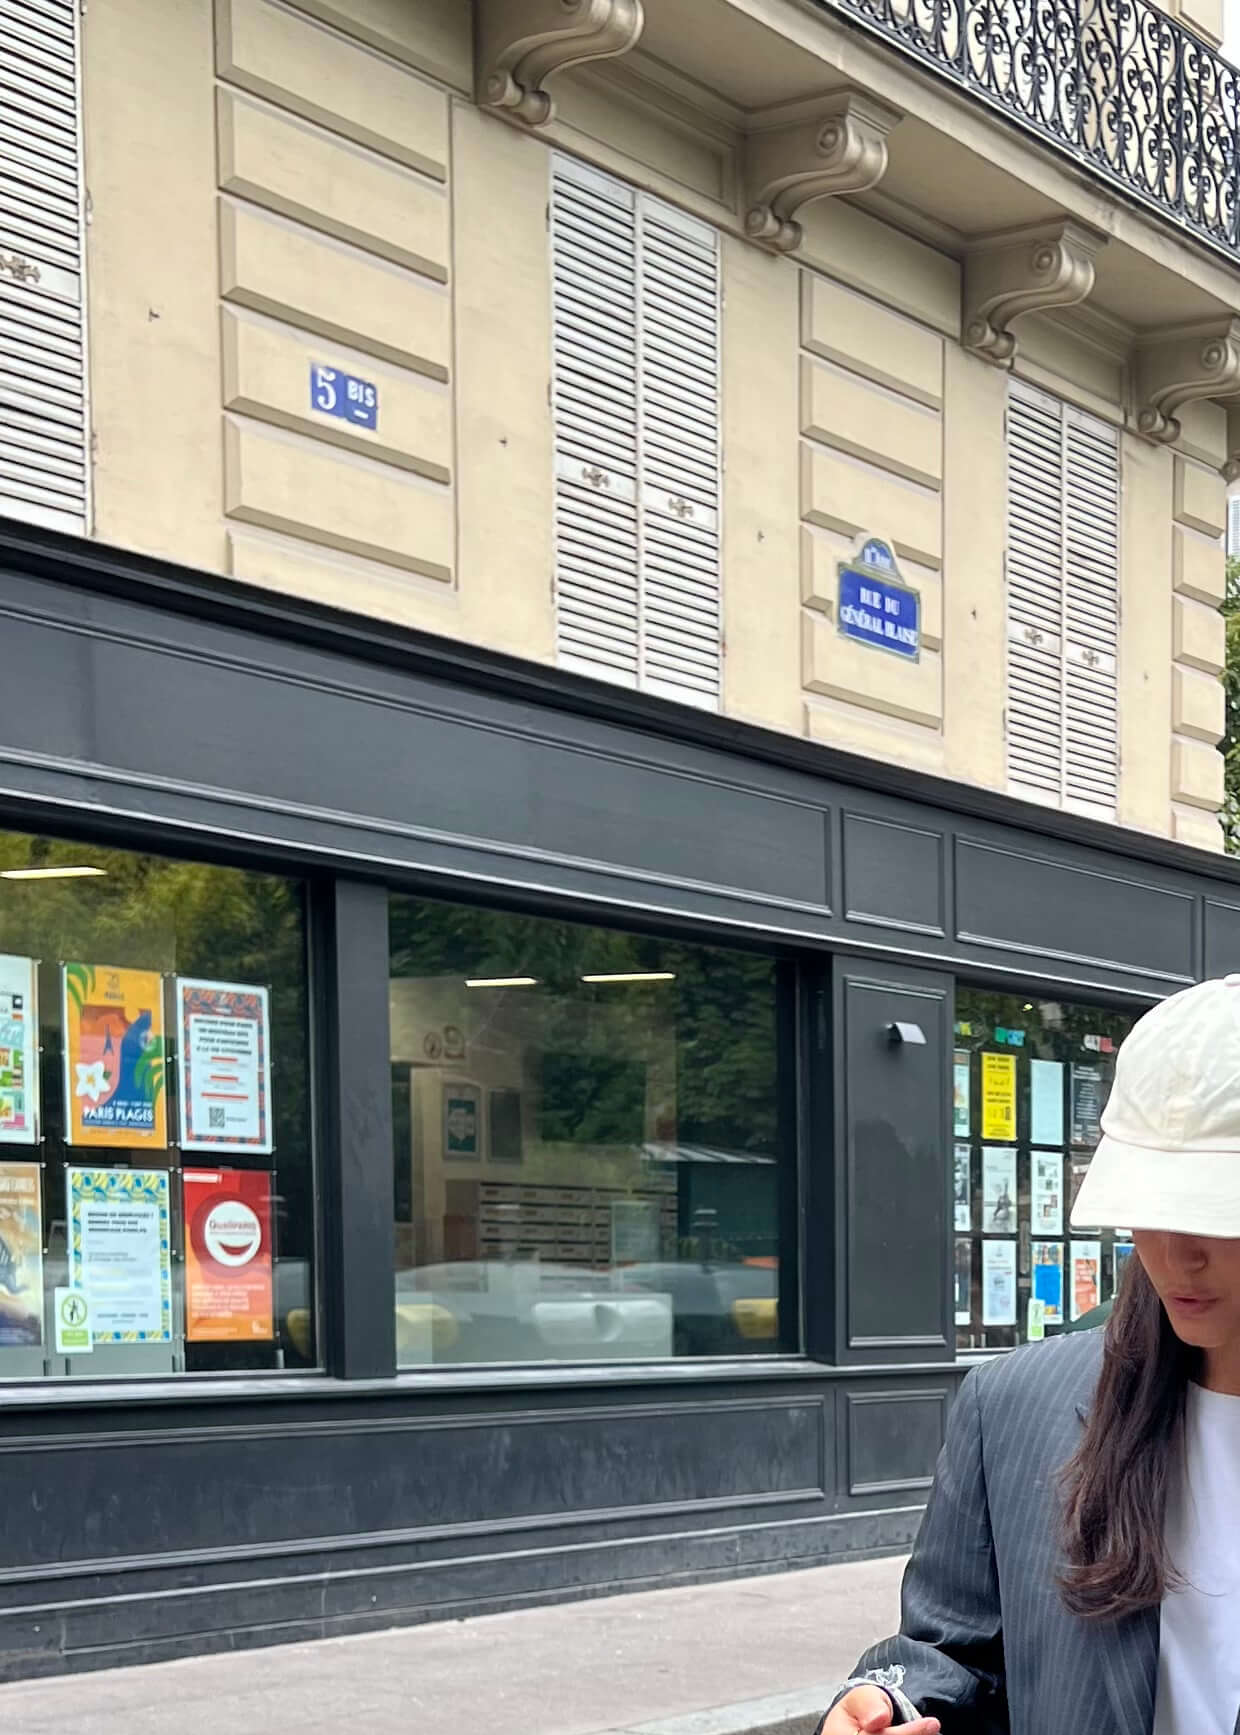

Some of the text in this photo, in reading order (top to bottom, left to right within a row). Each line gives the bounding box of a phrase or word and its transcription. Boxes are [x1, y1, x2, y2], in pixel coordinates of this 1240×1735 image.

[316, 367, 376, 411] 5 BIS
[83, 1105, 154, 1123] PARIS PLAGES
